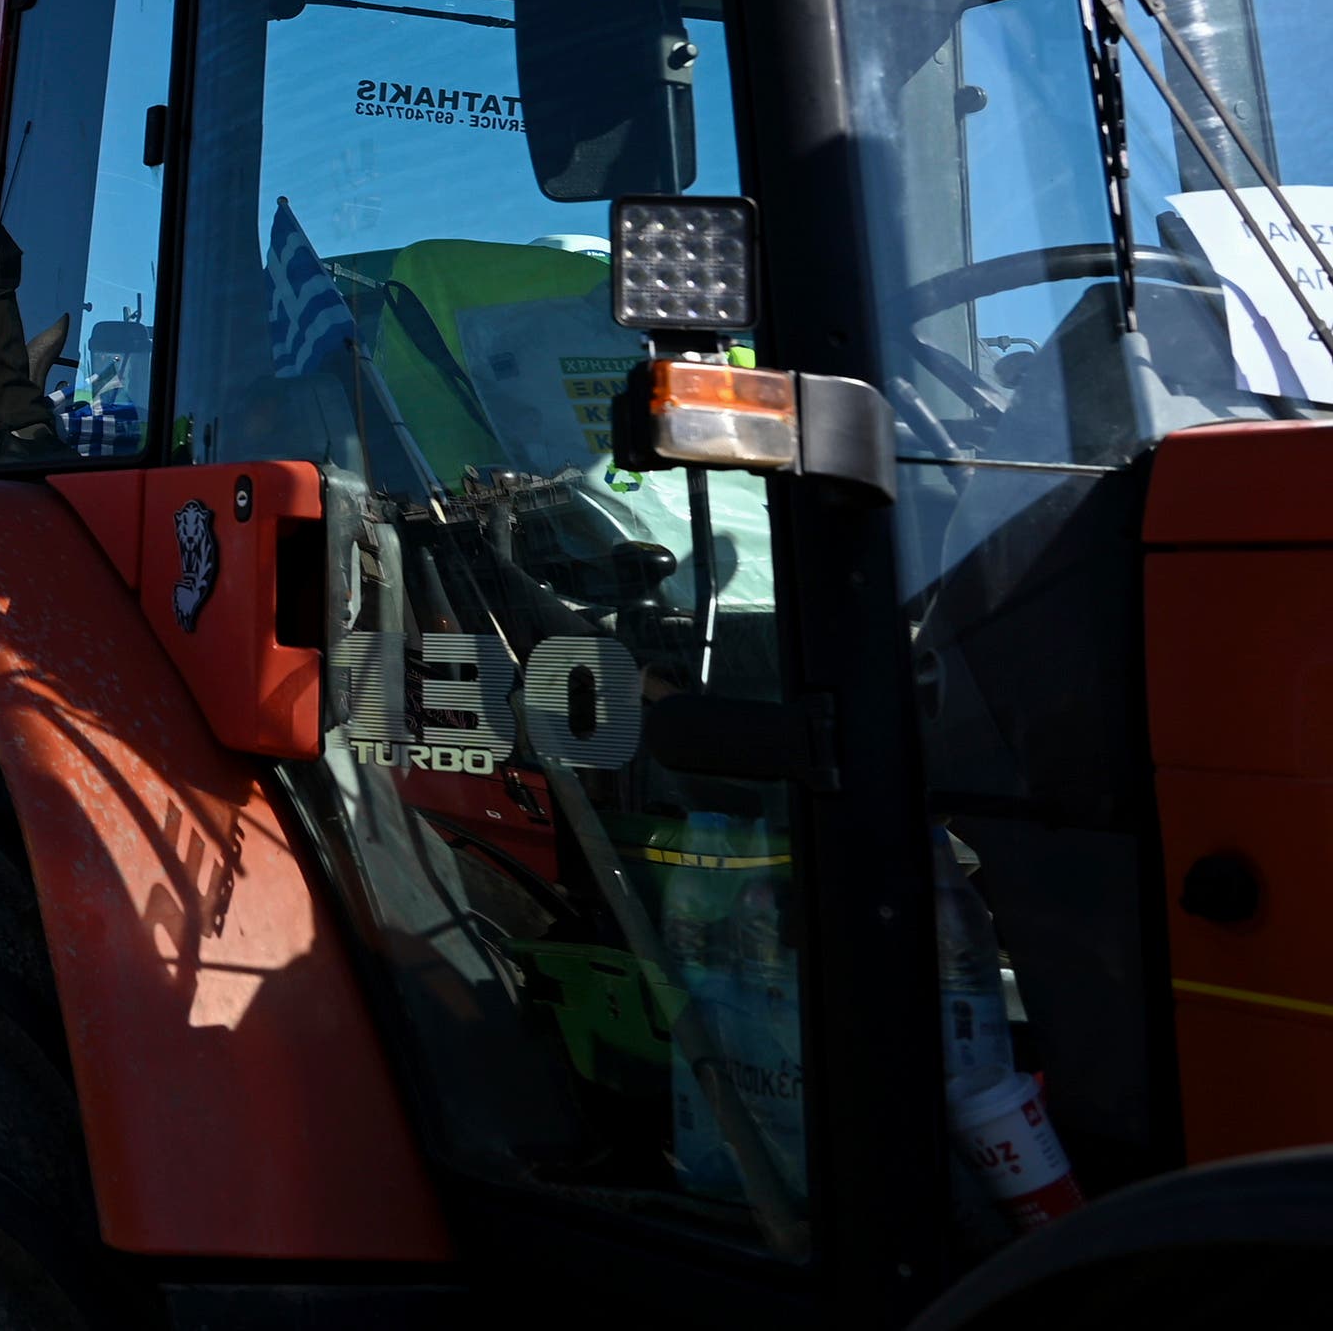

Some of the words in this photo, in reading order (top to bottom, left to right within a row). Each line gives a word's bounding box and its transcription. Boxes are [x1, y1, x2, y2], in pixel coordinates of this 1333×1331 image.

[564, 359, 637, 372] ΧΡΗΣΙΜ
[572, 380, 629, 397] ΞΑΝ
[330, 631, 643, 770] 130
[350, 741, 495, 775] TURBO
